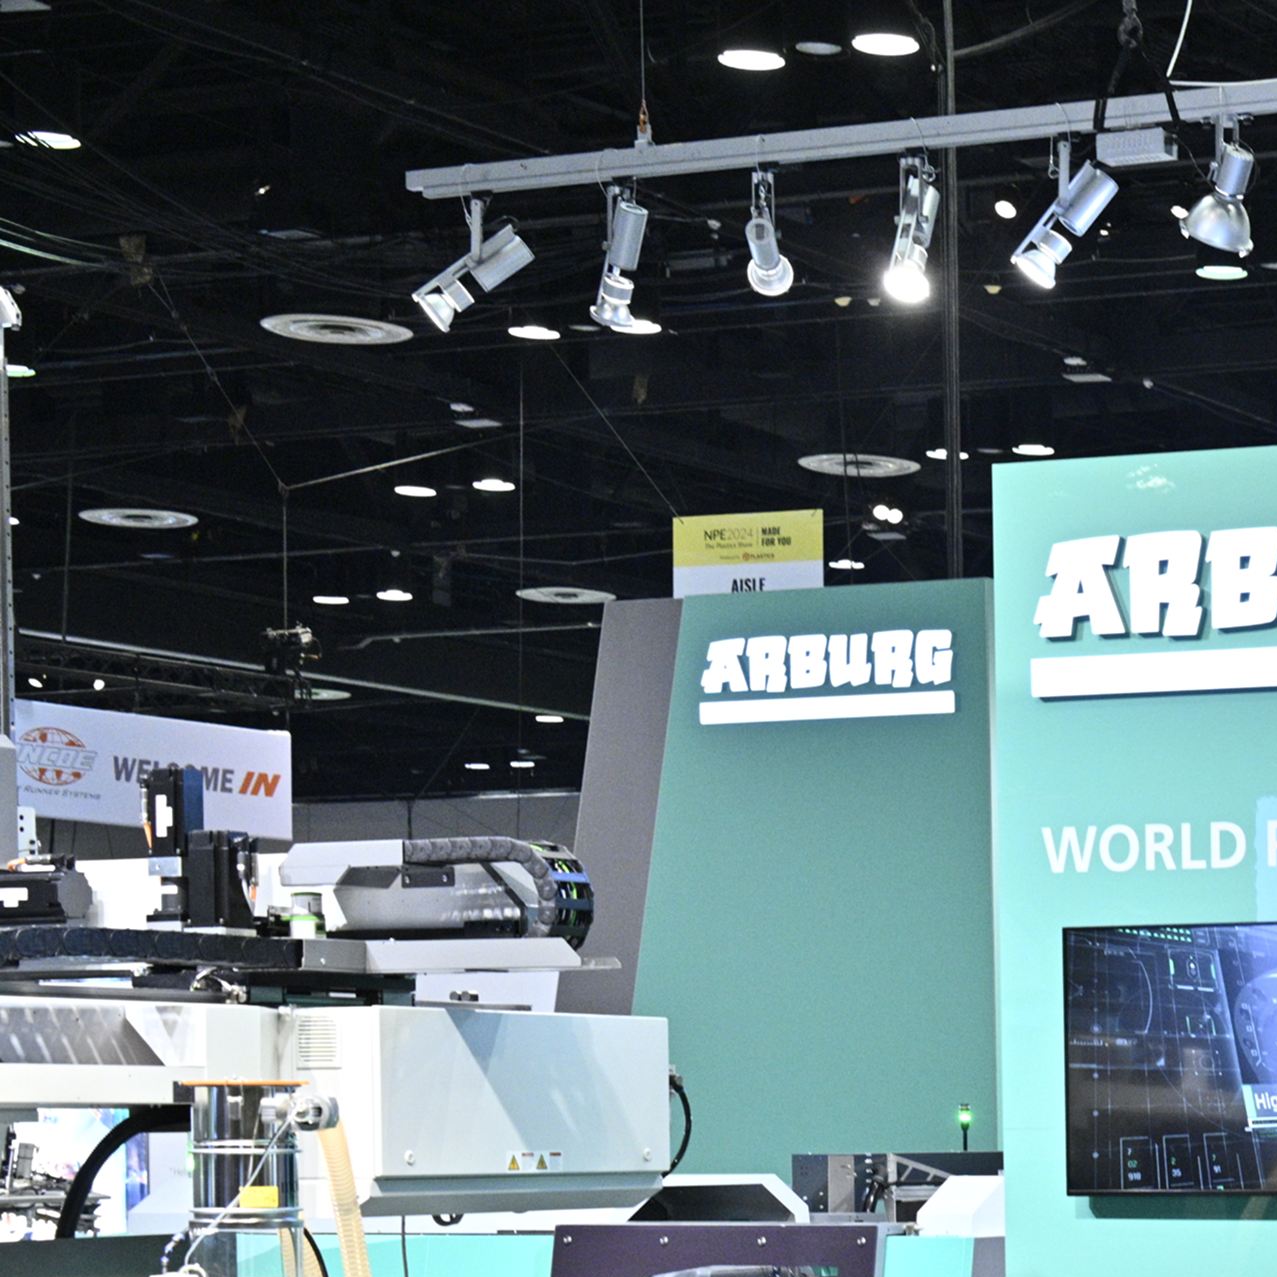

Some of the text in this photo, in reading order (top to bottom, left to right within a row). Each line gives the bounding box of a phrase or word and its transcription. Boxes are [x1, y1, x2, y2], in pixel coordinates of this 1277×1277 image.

[704, 528, 753, 541] NPE2024
[778, 536, 792, 546] YOU
[700, 629, 953, 693] ARBURG
[238, 771, 281, 797] IN
[1041, 821, 1247, 874] WORLD
